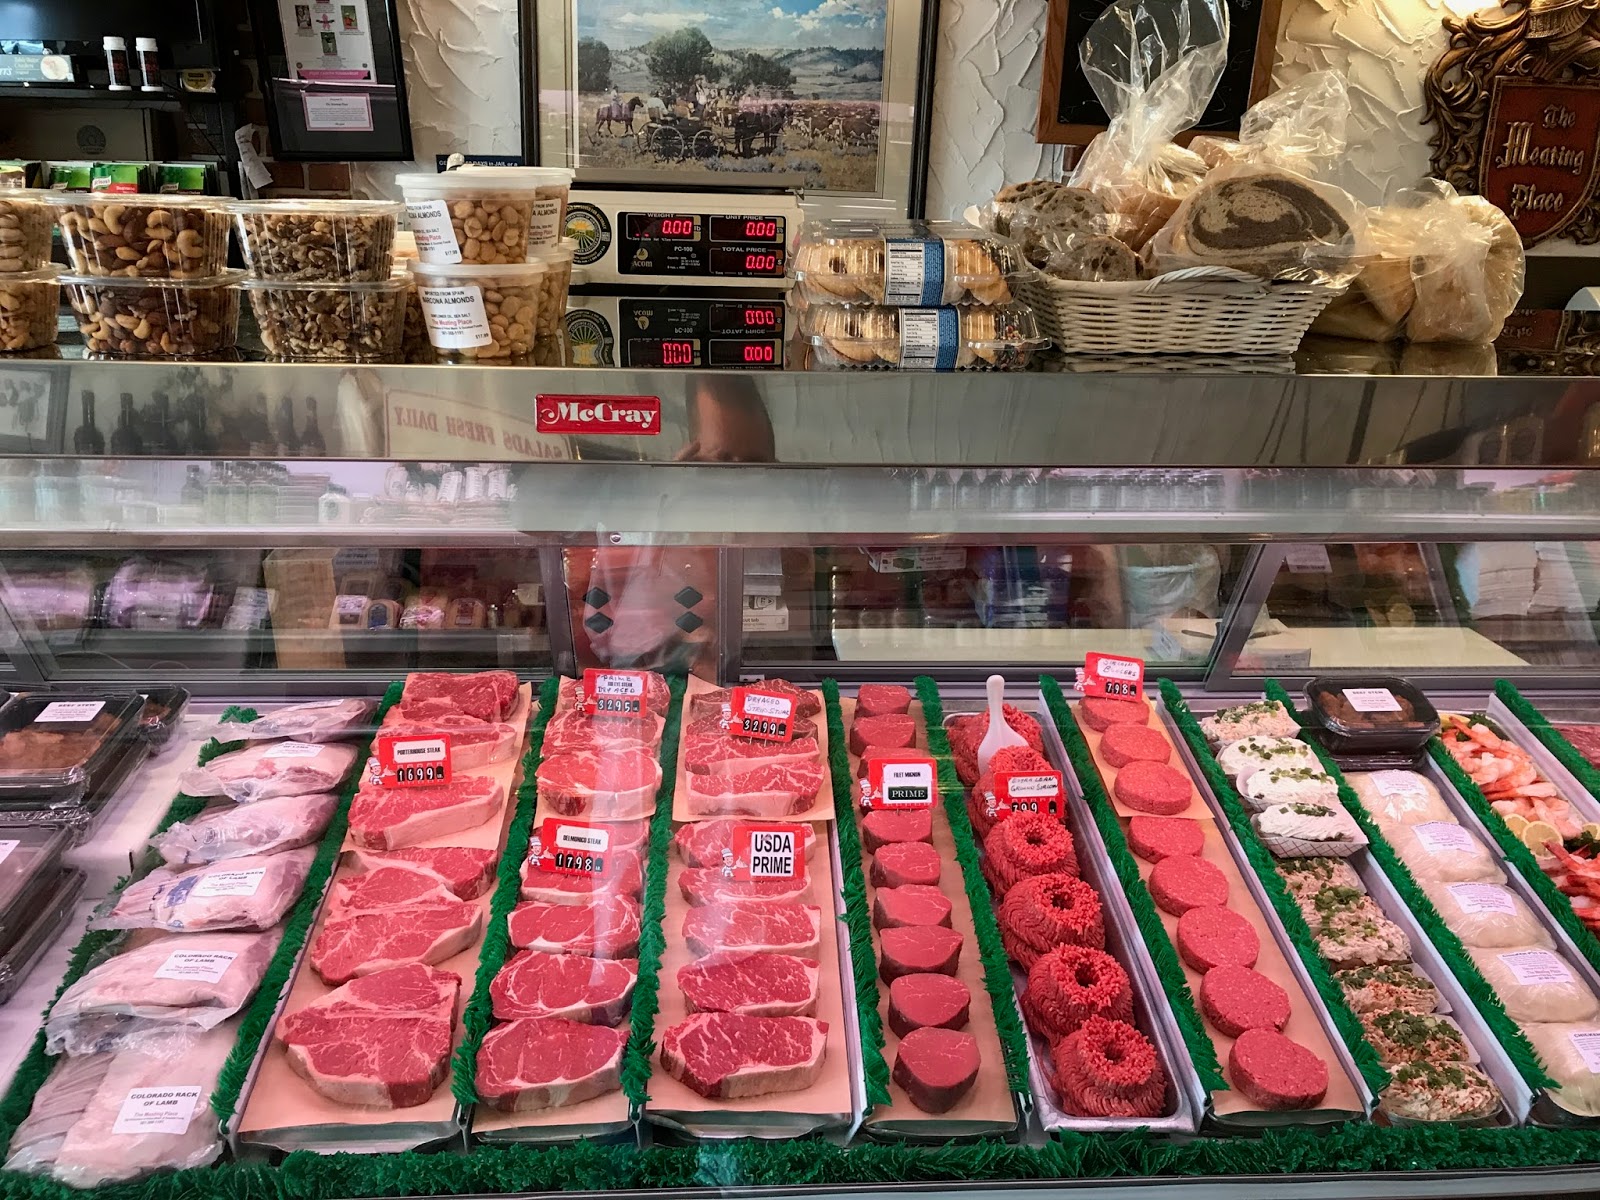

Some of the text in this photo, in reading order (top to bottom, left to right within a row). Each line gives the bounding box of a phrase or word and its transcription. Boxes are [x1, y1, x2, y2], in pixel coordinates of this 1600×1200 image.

[1542, 104, 1576, 128] The
[1508, 183, 1564, 220] Place
[662, 220, 692, 234] 0.00
[746, 222, 776, 236] 0.00
[745, 255, 775, 269] 0.00
[444, 296, 475, 304] ALMONDS
[540, 400, 657, 428] McCray
[892, 789, 925, 798] PRIME
[563, 834, 587, 843] DELMONICO
[755, 833, 792, 853] USDA
[752, 856, 792, 874] PRIME
